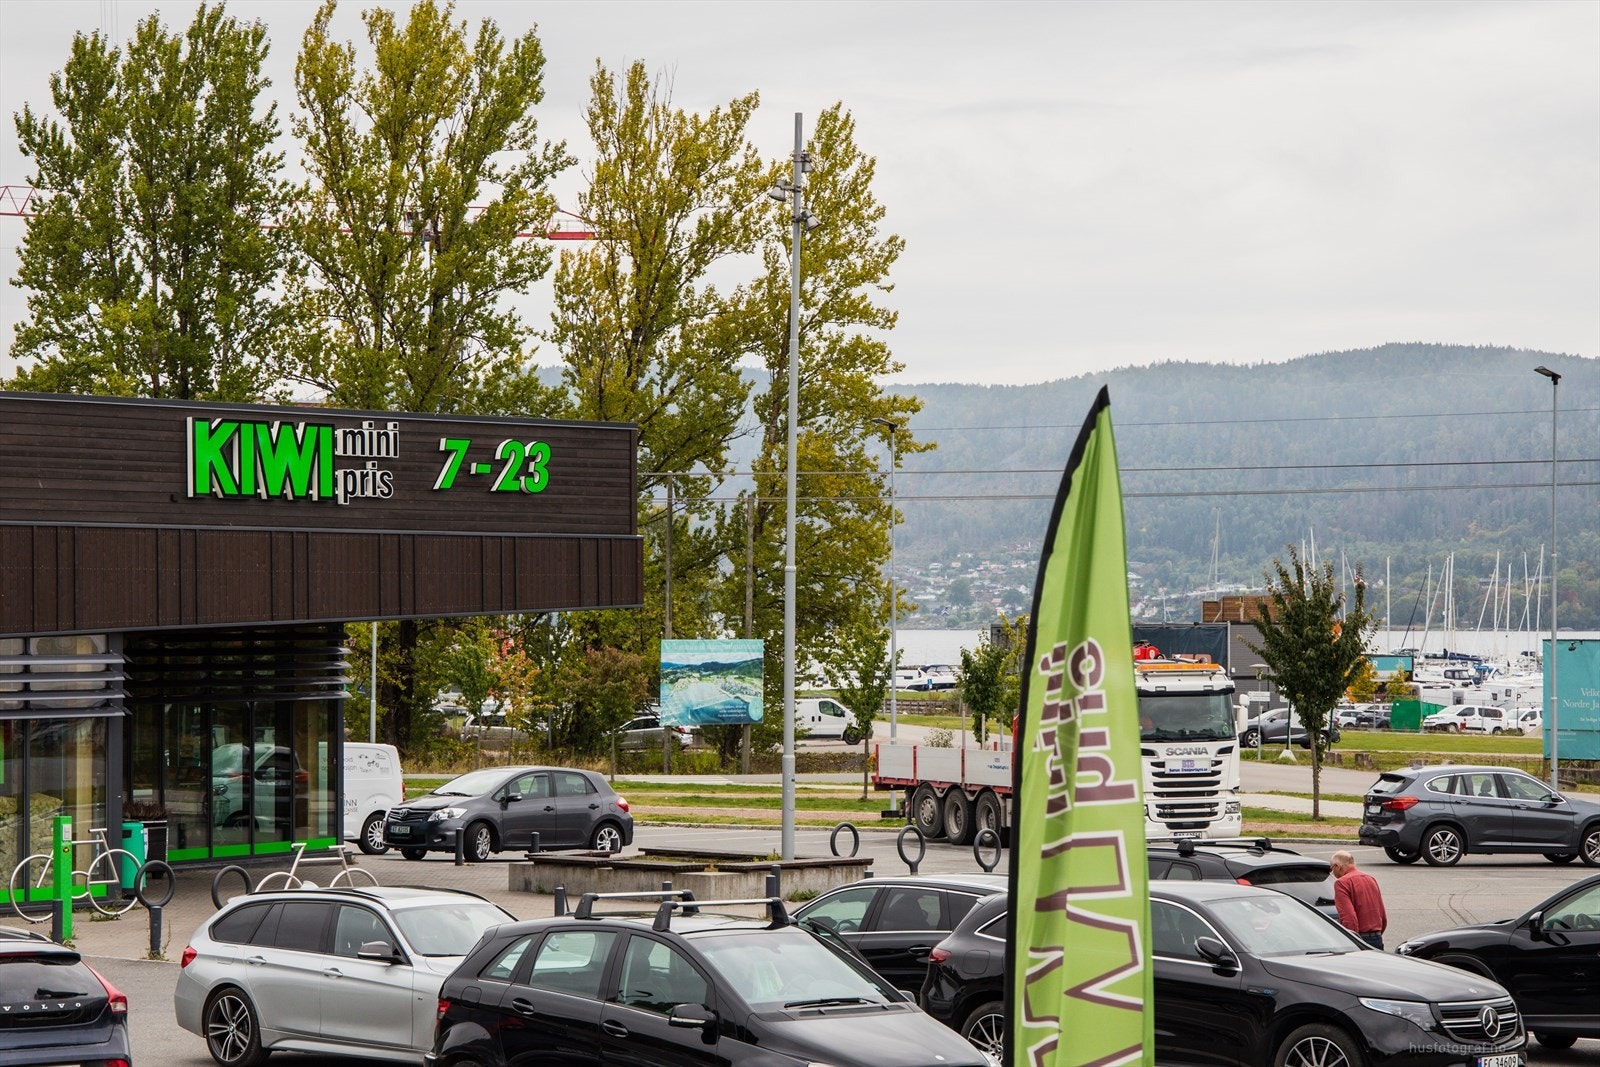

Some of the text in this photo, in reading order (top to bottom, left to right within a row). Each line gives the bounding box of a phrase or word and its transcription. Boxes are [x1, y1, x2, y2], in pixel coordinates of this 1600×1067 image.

[336, 420, 399, 458] mini
[187, 417, 336, 501] KIWI
[433, 438, 472, 490] 7
[490, 438, 551, 494] 23
[336, 461, 394, 504] pris
[1563, 699, 1590, 708] Nordre
[1165, 747, 1209, 756] SCANIA
[2, 1003, 82, 1012] VOLVO
